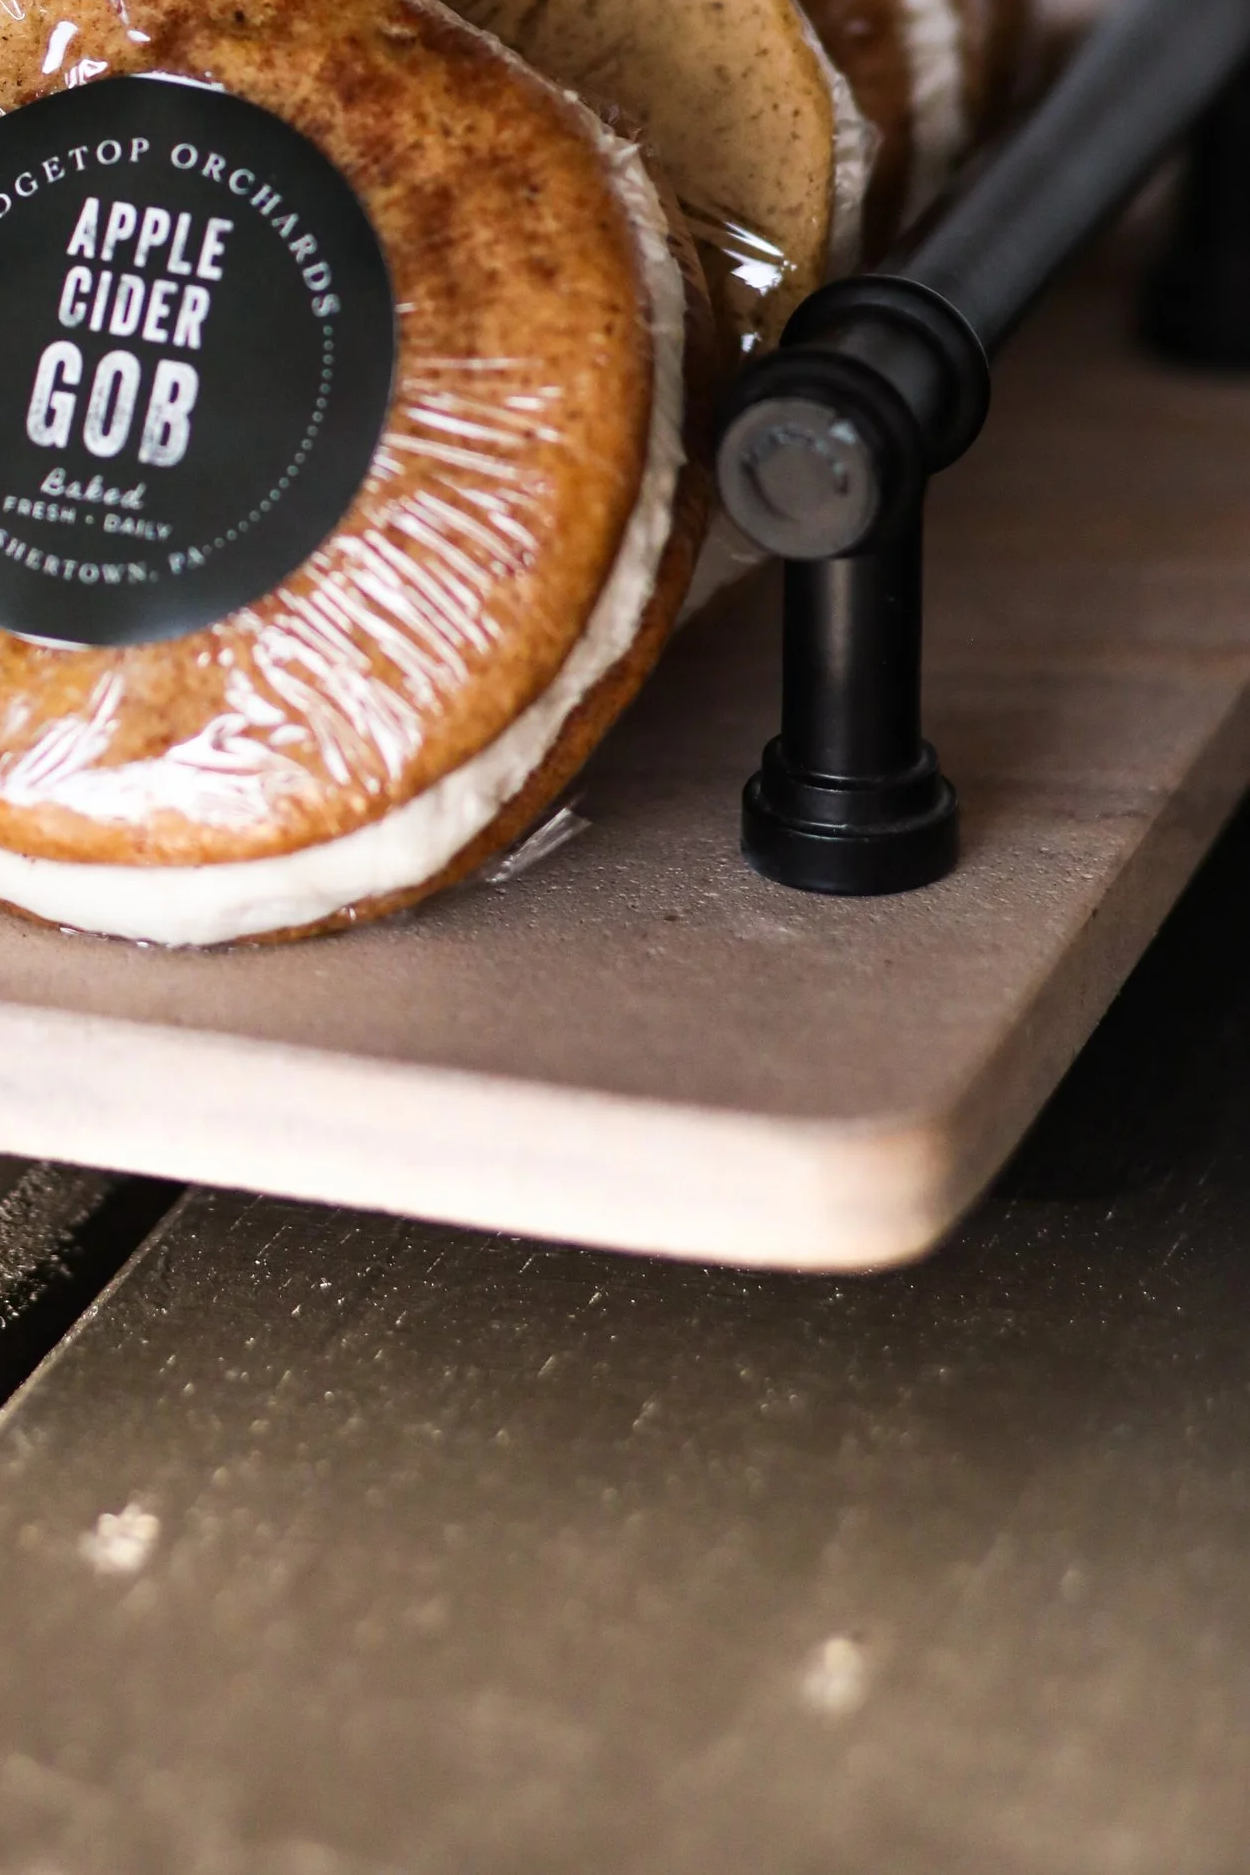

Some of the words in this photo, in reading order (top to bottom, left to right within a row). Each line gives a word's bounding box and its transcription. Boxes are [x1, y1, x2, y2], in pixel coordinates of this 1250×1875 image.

[66, 196, 234, 281] APPLE
[170, 142, 341, 318] ORCHARDS
[57, 266, 210, 349] CIDER
[25, 340, 200, 467] GOB
[3, 495, 76, 524] FRESH
[103, 513, 172, 541] DAILY
[40, 467, 146, 510] Baked
